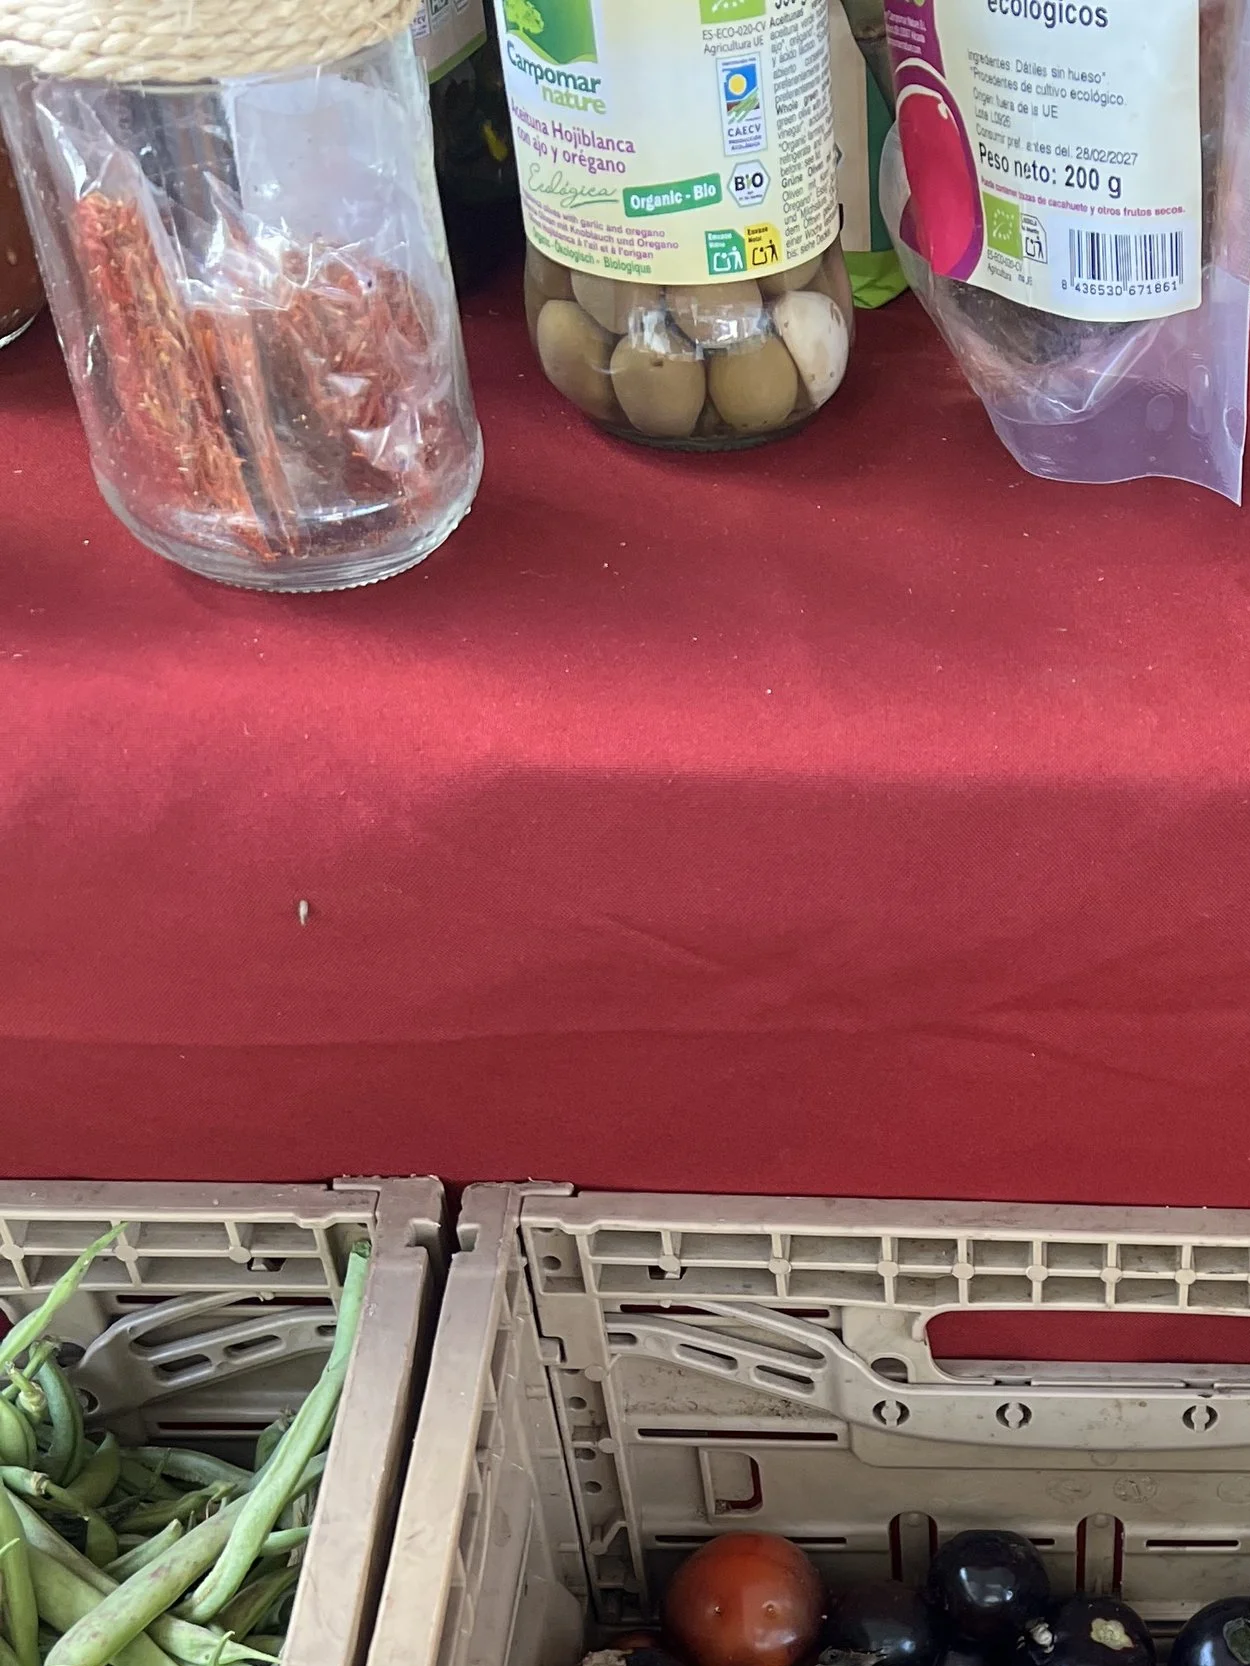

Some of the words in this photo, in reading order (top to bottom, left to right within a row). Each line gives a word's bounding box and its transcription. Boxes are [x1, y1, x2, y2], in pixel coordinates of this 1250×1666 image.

[702, 20, 766, 41] ES-ECO-020-CV
[703, 39, 751, 56] Agricultura
[753, 34, 764, 46] UE
[507, 41, 601, 93] Campomar
[1015, 58, 1047, 78] Dátiles
[1051, 66, 1065, 80] sin
[541, 85, 607, 115] nature
[1020, 81, 1032, 94] de
[1035, 83, 1067, 99] cultivo
[1017, 101, 1029, 114] de
[1042, 104, 1059, 119] UE
[551, 119, 636, 154] Hojiblanca
[727, 123, 762, 138] CAECV
[532, 134, 548, 157] ajo
[550, 145, 559, 163] y
[562, 148, 627, 175] orégano
[1075, 146, 1139, 166] 28/02/2027
[979, 142, 1009, 173] Peso
[1014, 160, 1057, 185] neto:
[1064, 165, 1100, 191] 200
[1107, 175, 1122, 199] g
[630, 190, 683, 211] Organic
[693, 183, 717, 201] Bio
[1090, 204, 1096, 216] y
[1098, 205, 1121, 217] otros
[1123, 206, 1152, 218] frutos
[580, 216, 604, 232] garlic
[606, 222, 623, 235] and
[626, 227, 666, 240] oregano
[617, 236, 635, 247] und
[636, 238, 679, 251] Oregano
[603, 257, 652, 276] Biologique
[1074, 283, 1123, 297] 436530
[1128, 280, 1178, 297] 671861
